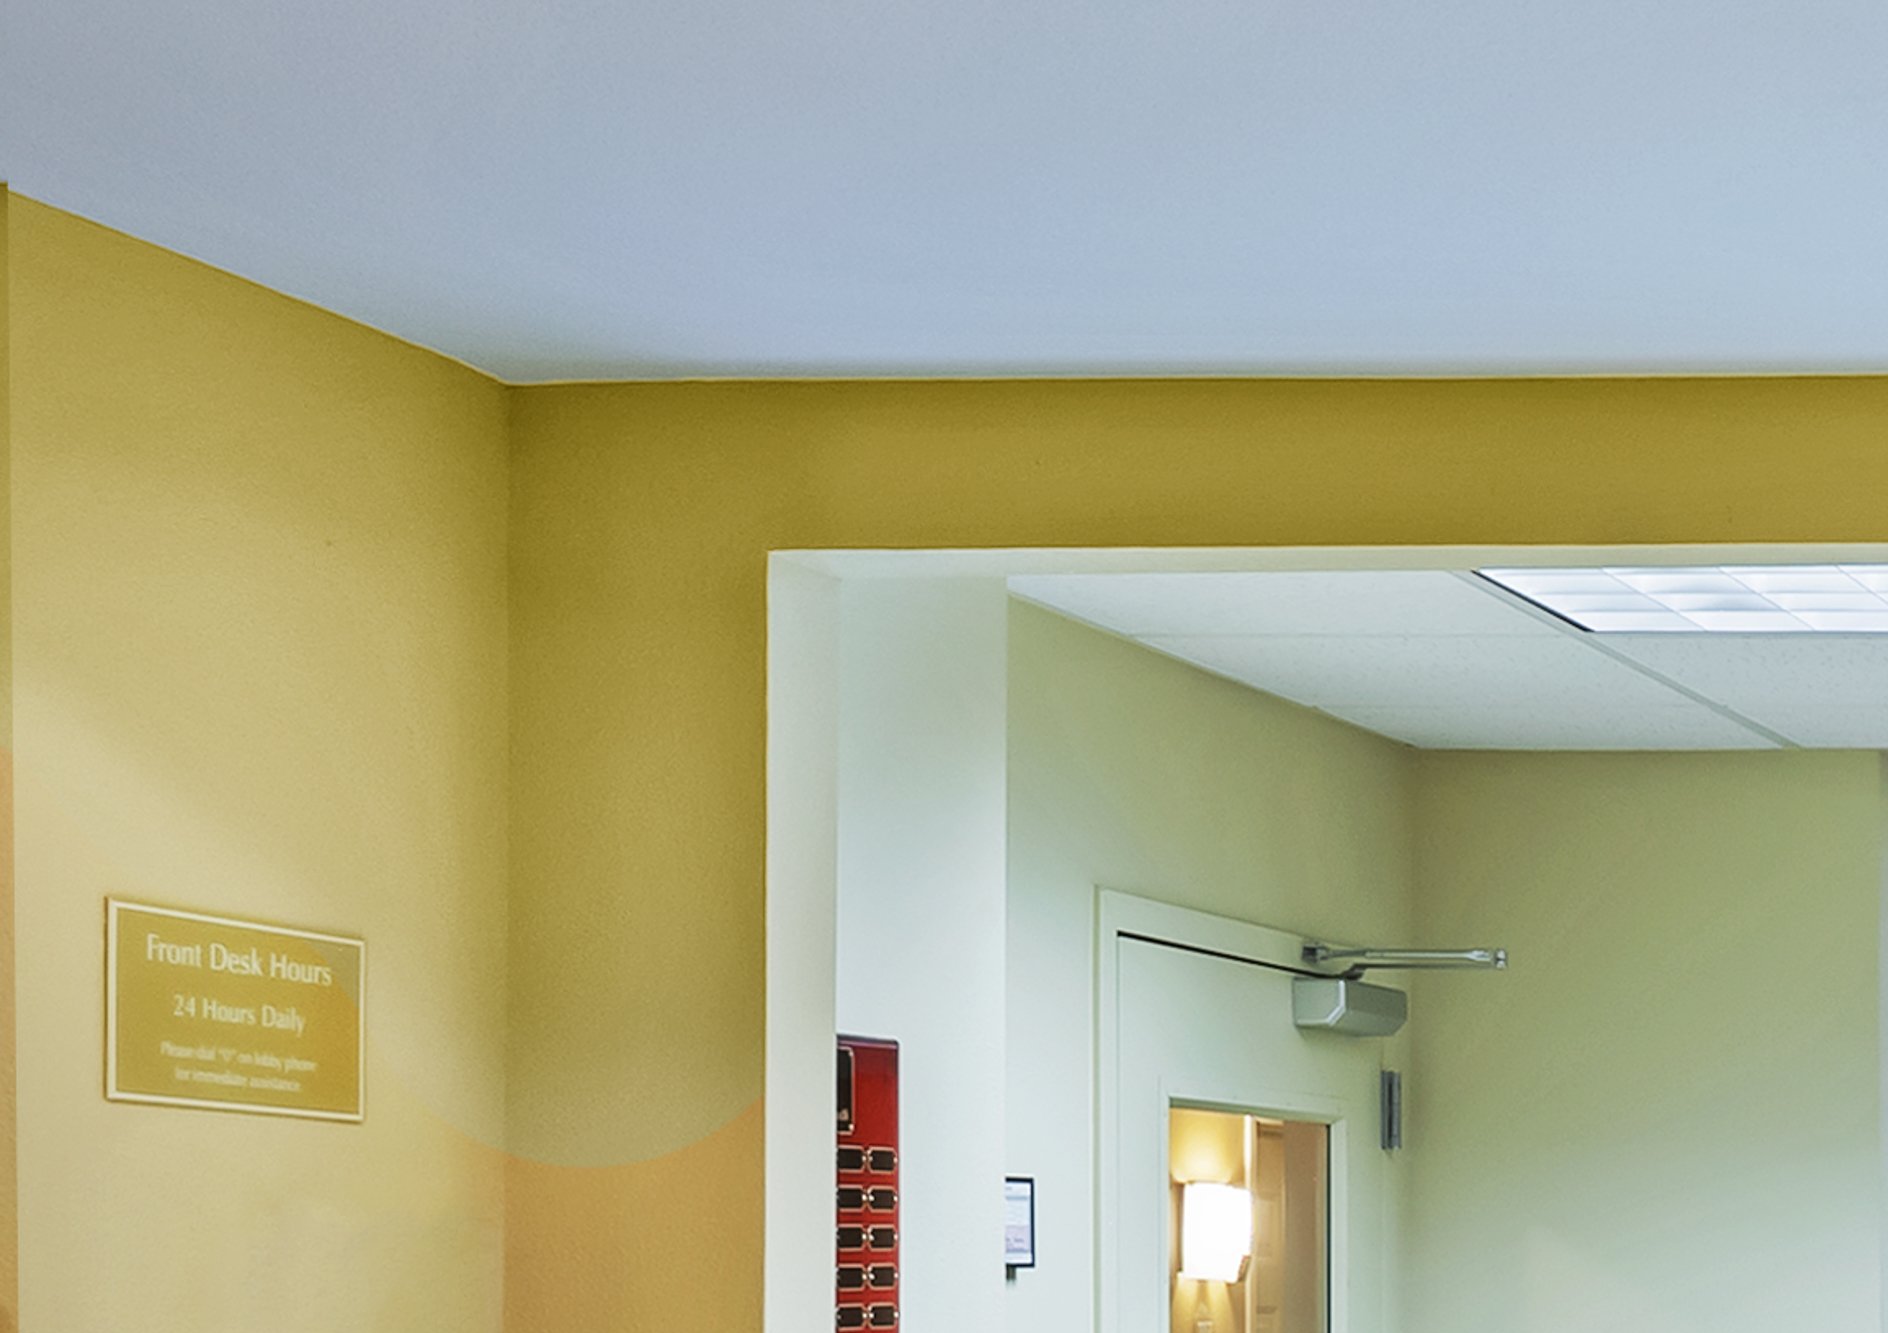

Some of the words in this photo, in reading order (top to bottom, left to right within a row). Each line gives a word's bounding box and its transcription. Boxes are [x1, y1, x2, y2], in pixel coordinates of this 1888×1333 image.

[146, 932, 203, 968] Front
[208, 942, 263, 977] Desk
[268, 953, 333, 986] Hours
[172, 994, 197, 1018] 24
[202, 998, 256, 1025] Hours
[261, 1004, 306, 1037] Daily
